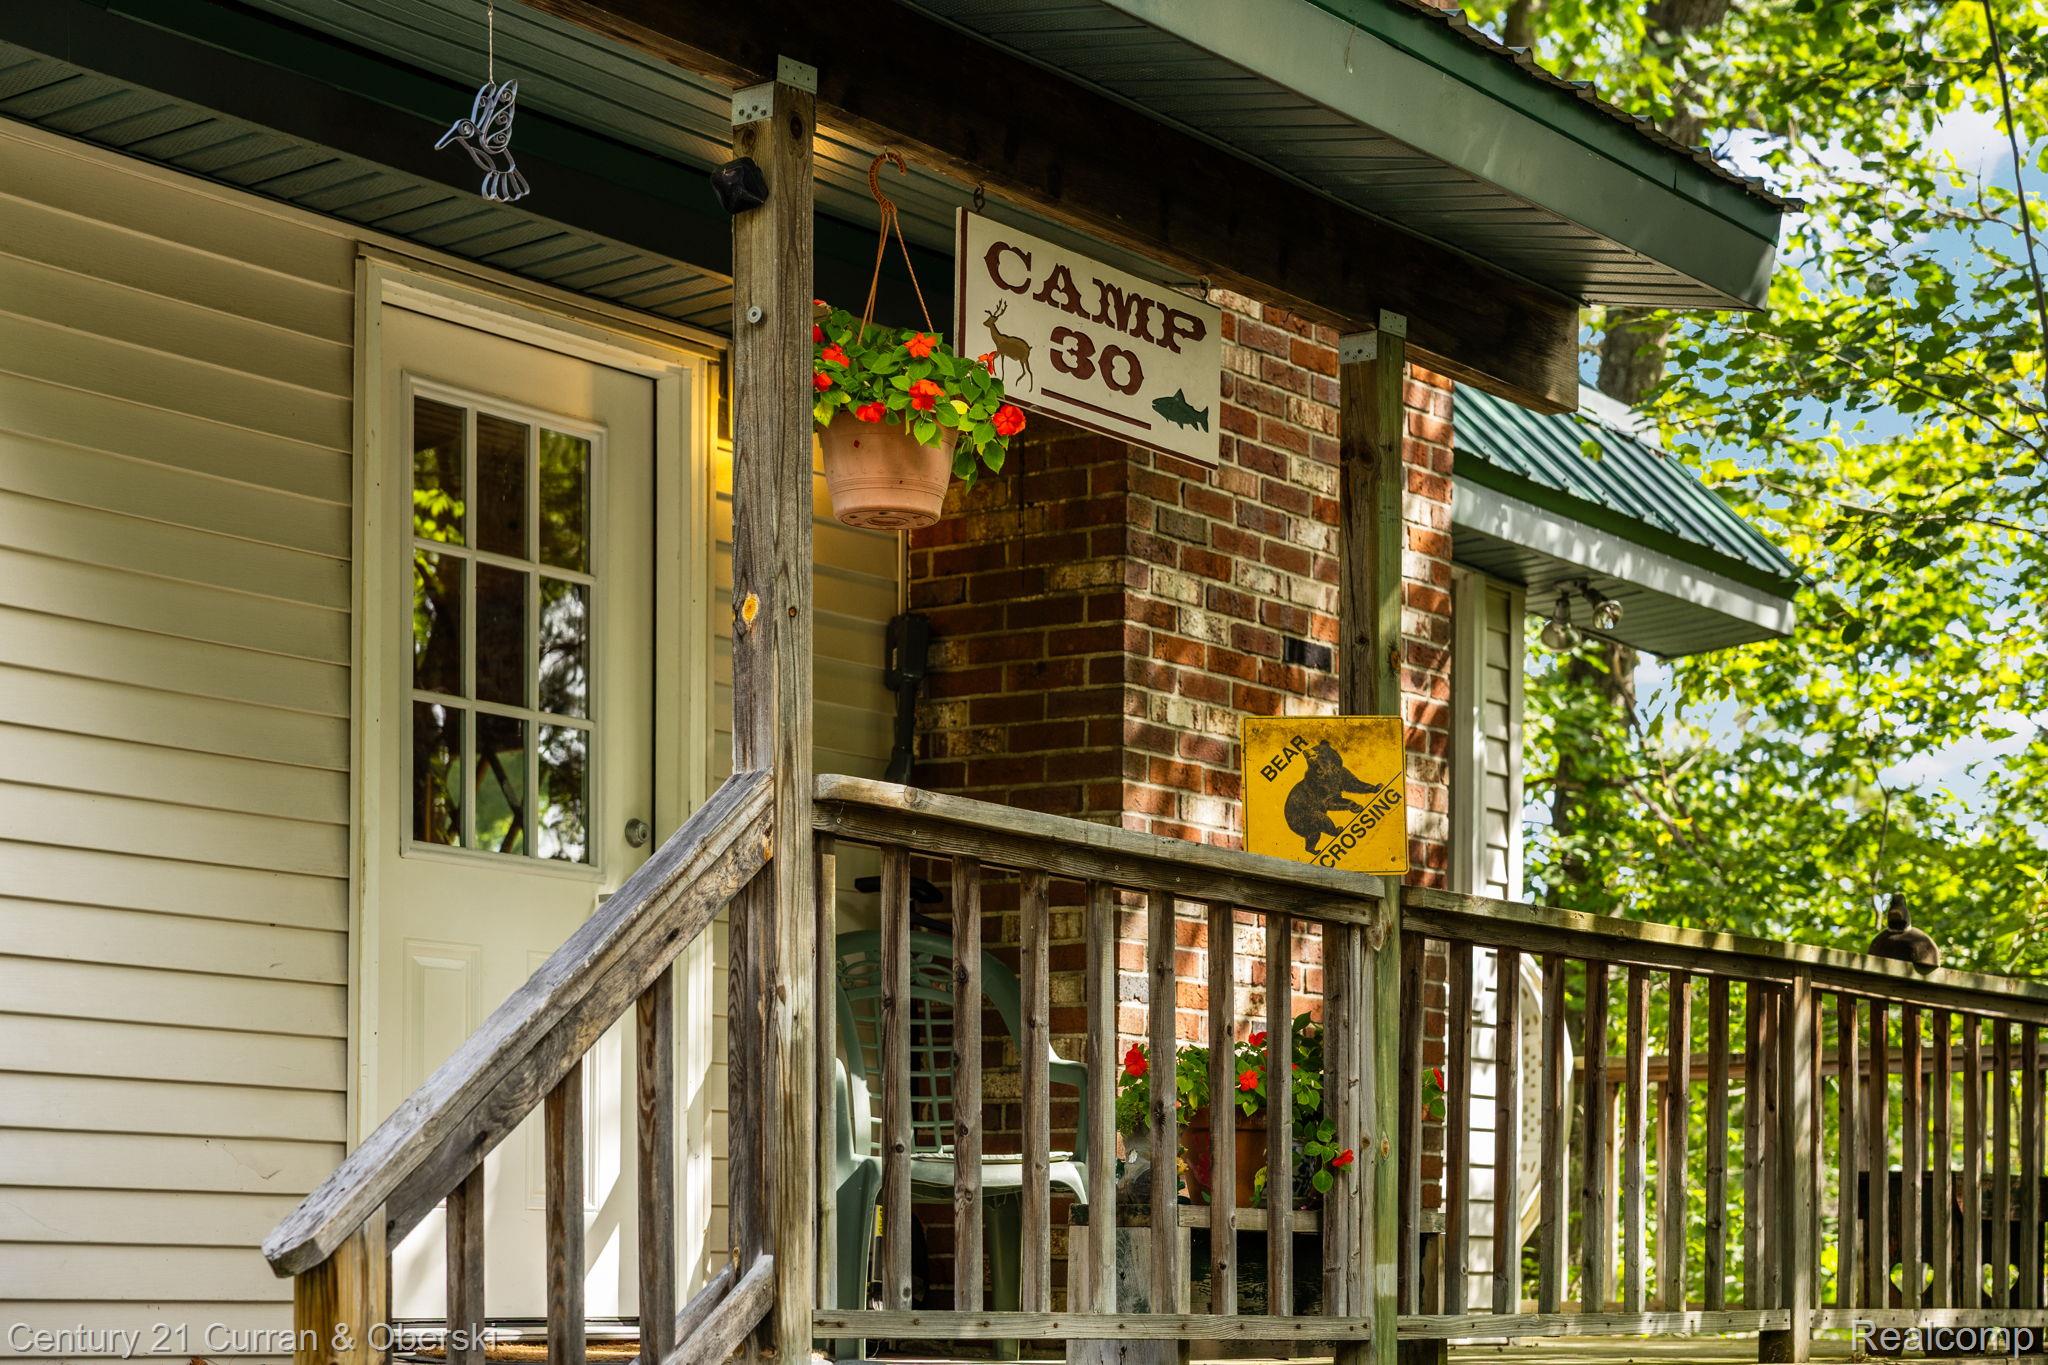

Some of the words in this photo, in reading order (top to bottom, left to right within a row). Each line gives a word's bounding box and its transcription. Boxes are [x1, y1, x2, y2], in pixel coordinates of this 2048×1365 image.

[984, 241, 1207, 354] CAMP
[1050, 326, 1145, 396] 30
[1260, 735, 1309, 782] BEAR
[1319, 788, 1402, 868] CROSSING
